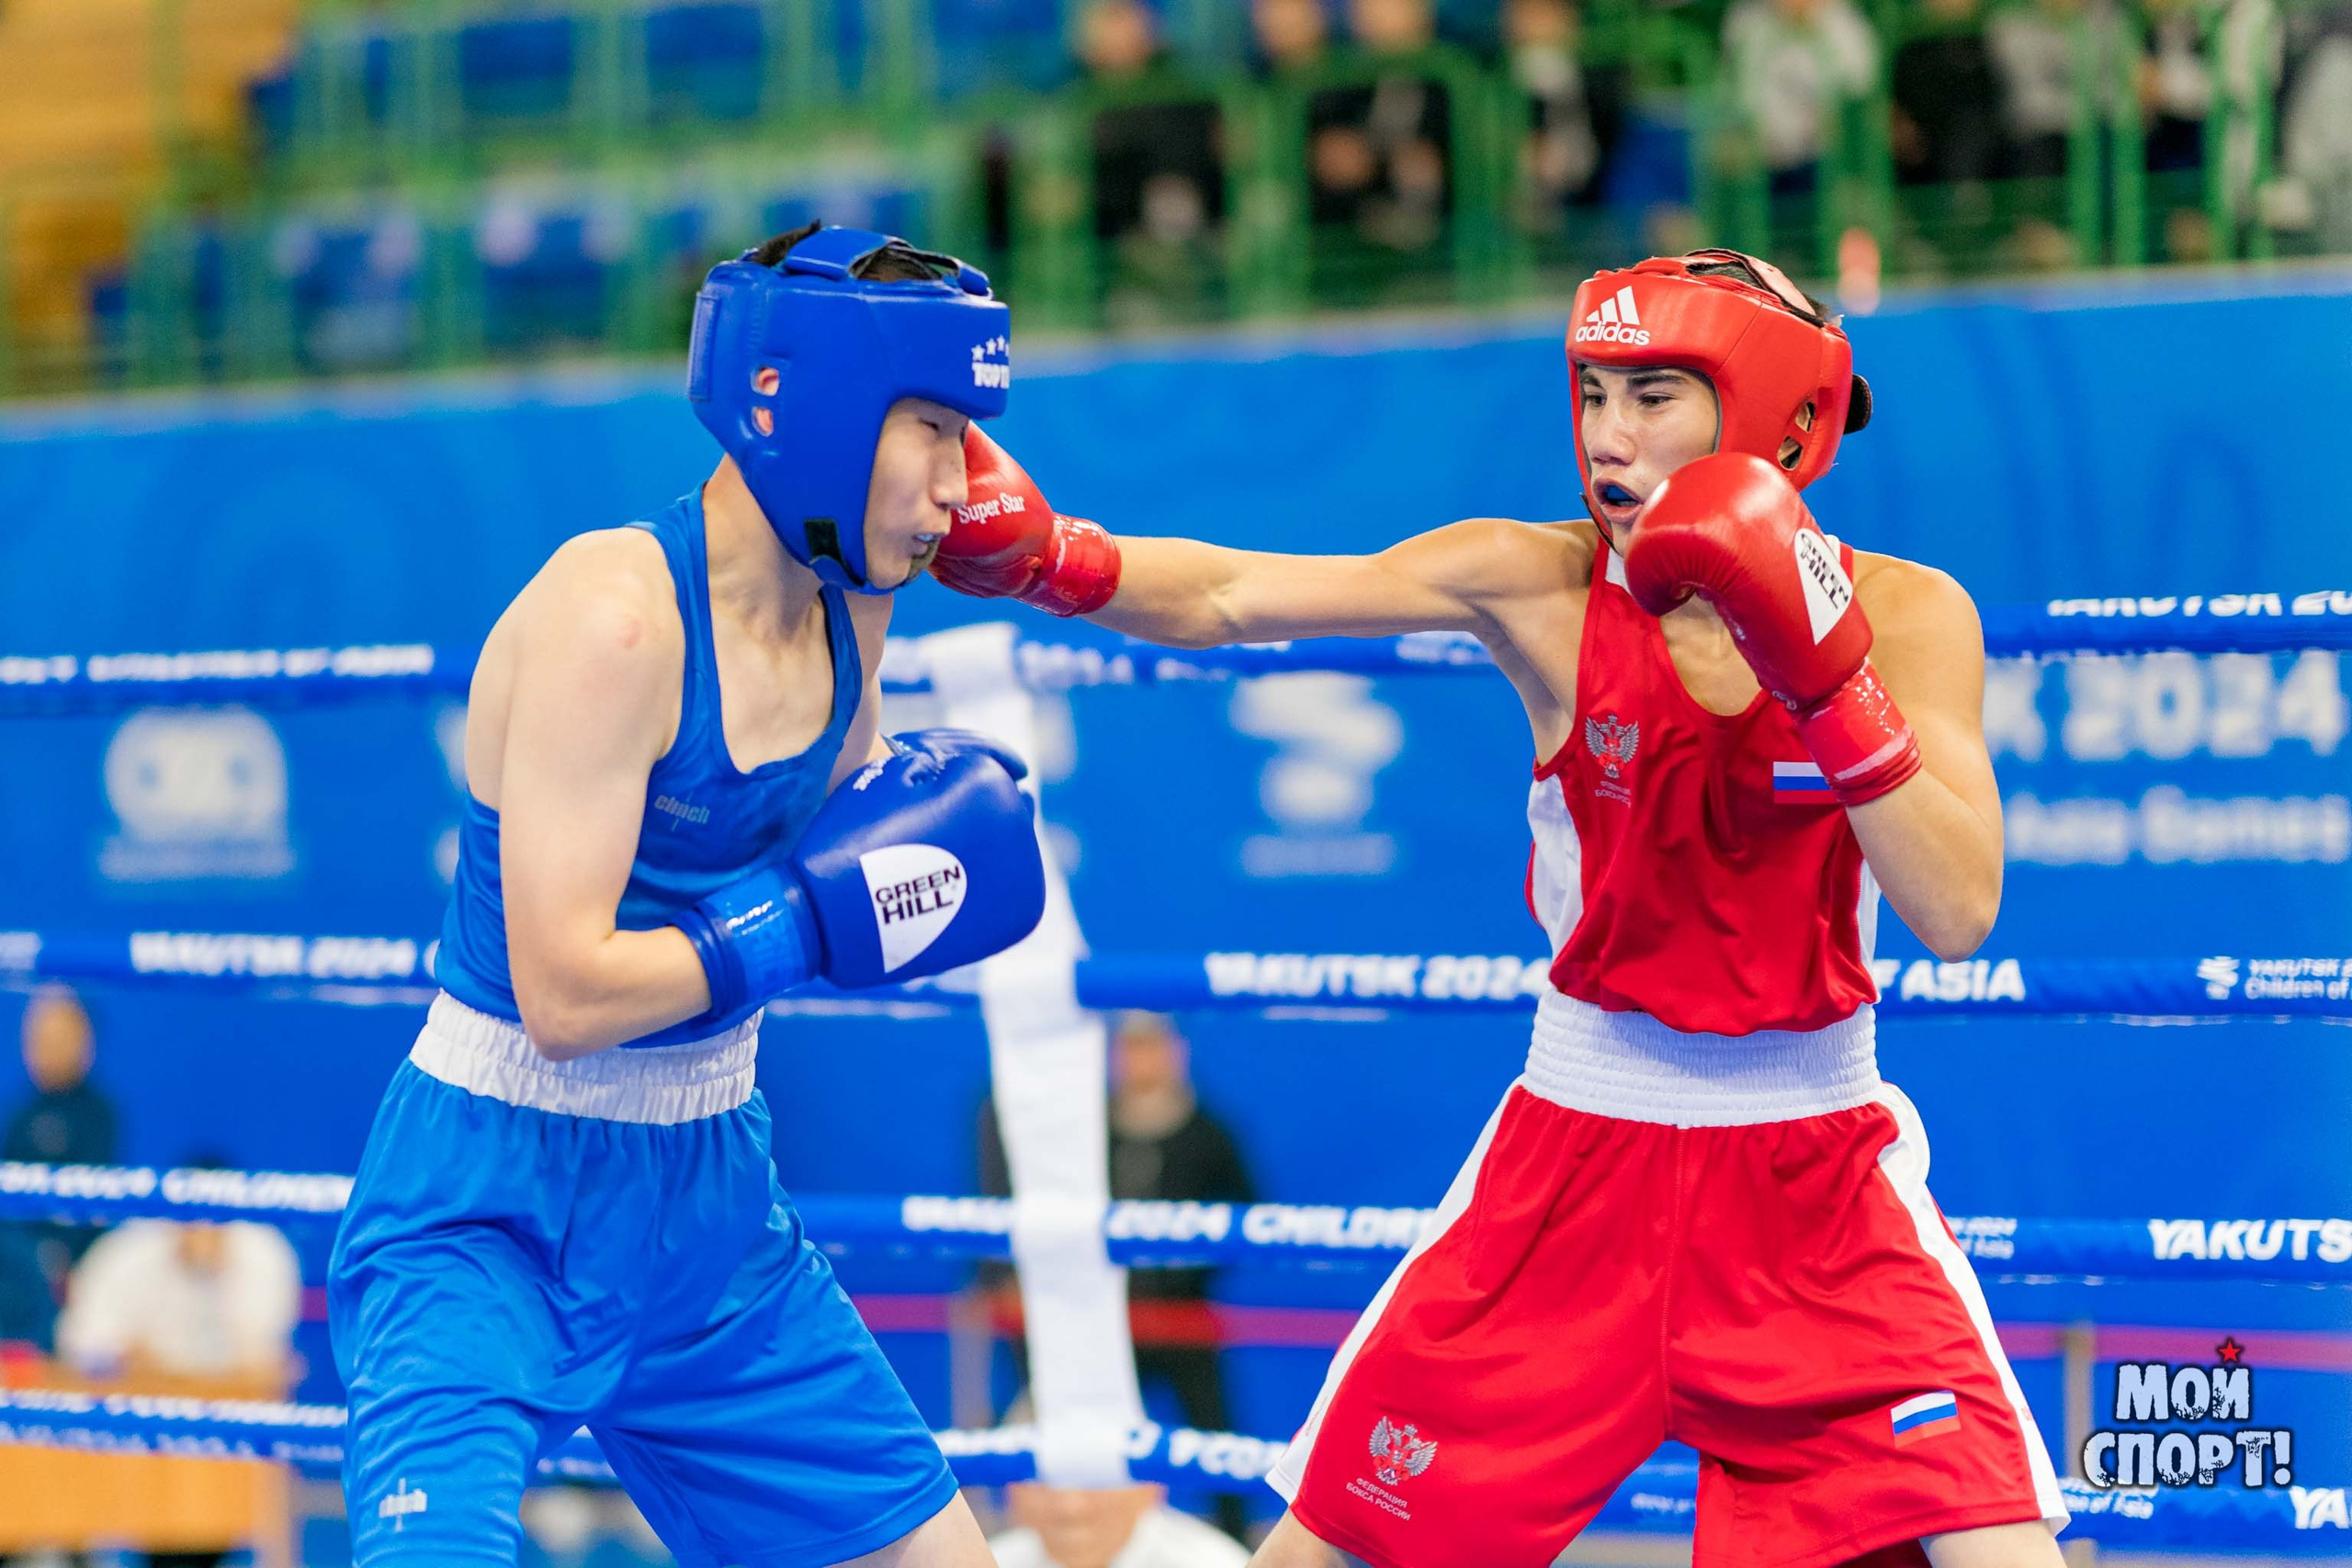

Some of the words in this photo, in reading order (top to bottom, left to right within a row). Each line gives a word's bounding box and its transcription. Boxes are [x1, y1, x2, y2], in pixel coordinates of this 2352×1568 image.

[1575, 321, 1651, 346] adidas
[957, 499, 1001, 525] Super
[1000, 492, 1025, 514] Star
[875, 865, 961, 905] GREEN
[882, 890, 954, 925] HILL
[1204, 952, 1413, 998] YAKUTSK
[1900, 957, 2027, 1002] ASIA
[1106, 1200, 1233, 1241] 2024
[2147, 1218, 2352, 1263] YAKUTS
[1345, 1482, 1374, 1504] БОКСА
[1374, 1497, 1411, 1521] РОССИИ
[1356, 1477, 1408, 1508] ФЕДЕРАЦИЯ
